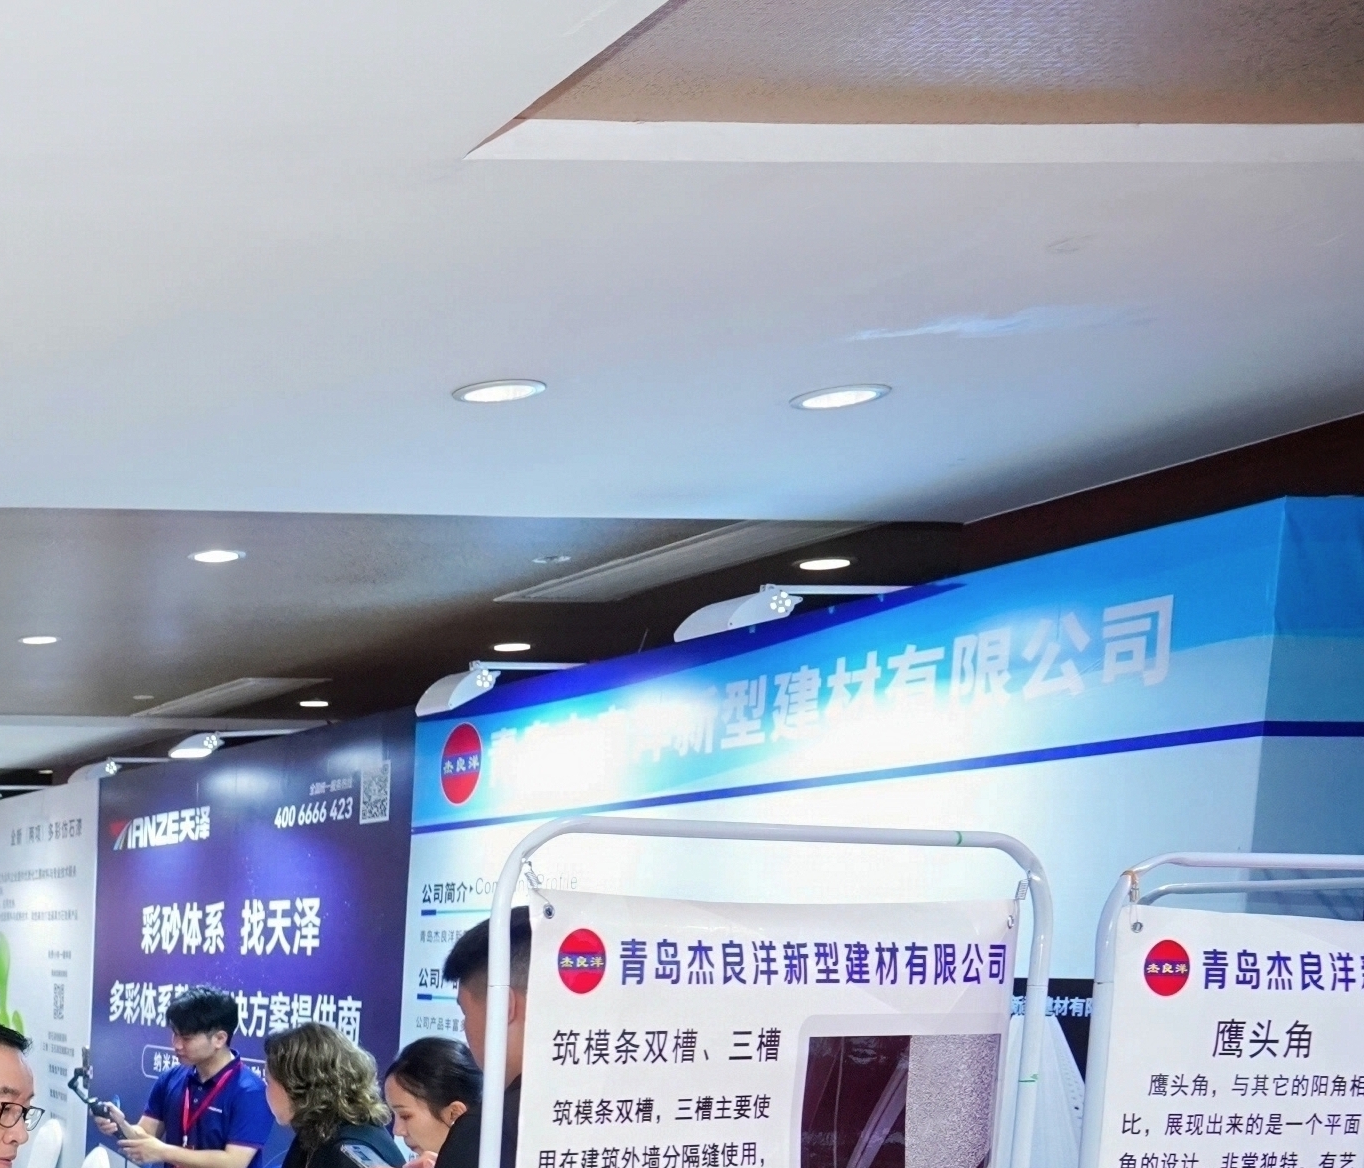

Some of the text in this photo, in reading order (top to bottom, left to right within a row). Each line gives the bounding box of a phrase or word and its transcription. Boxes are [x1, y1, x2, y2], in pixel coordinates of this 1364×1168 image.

[274, 796, 354, 829] 400 6666 423
[422, 882, 467, 904] 公司简介
[141, 901, 225, 954] 彩砂体系
[240, 897, 321, 956] 找天泽
[559, 955, 605, 969] 杰良洋
[620, 938, 1008, 987] 青岛杰良洋新型建材有限公司
[1146, 962, 1189, 975] 杰良洋
[1202, 949, 1364, 993] 青岛杰良洋
[552, 1027, 782, 1067] 筑模条双槽、三槽
[1212, 1018, 1313, 1059] 鹰头角
[552, 1093, 771, 1126] 筑模条双槽，三槽主要使
[1121, 1112, 1362, 1137] 比，展现出来的是一个平面
